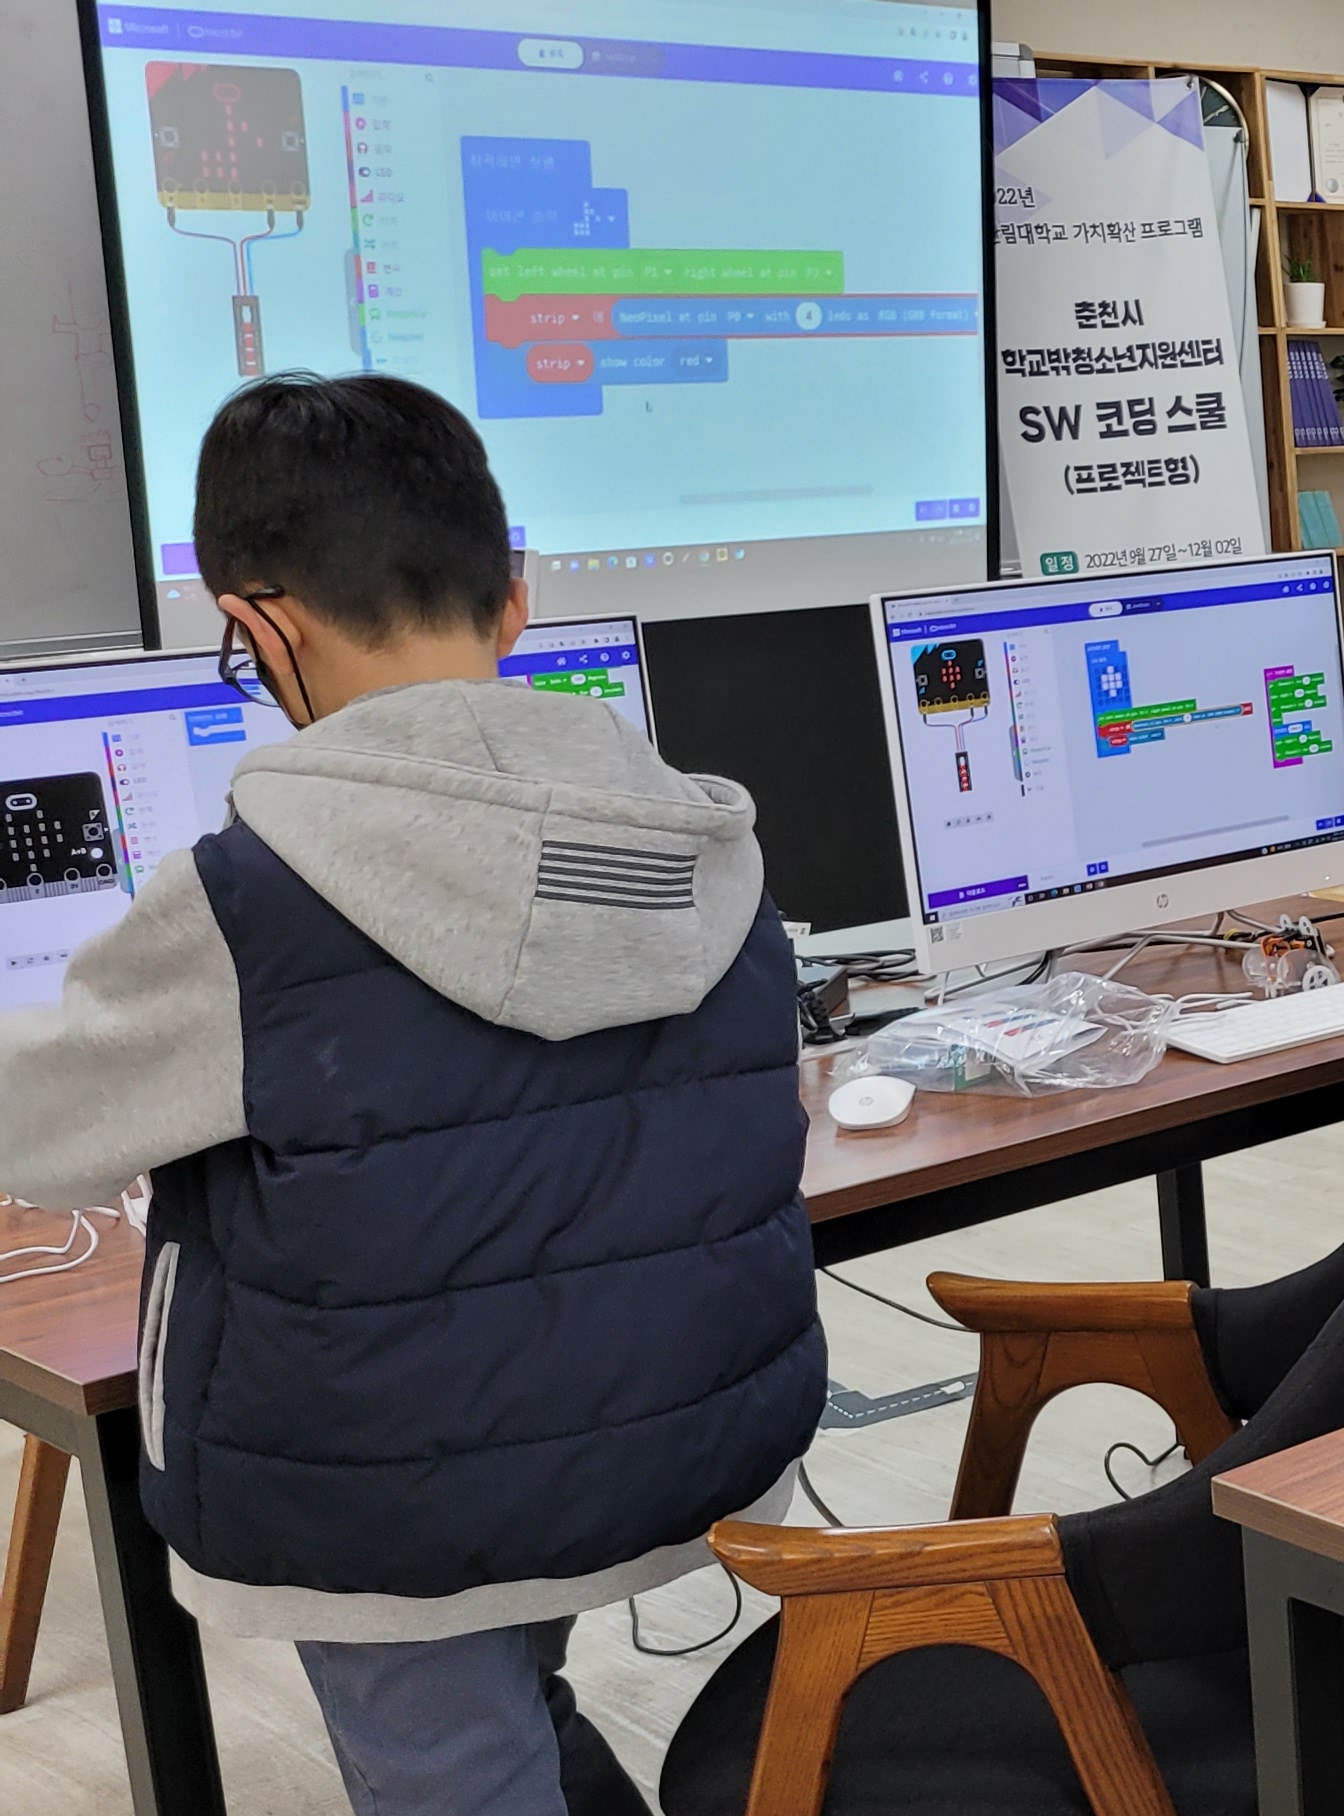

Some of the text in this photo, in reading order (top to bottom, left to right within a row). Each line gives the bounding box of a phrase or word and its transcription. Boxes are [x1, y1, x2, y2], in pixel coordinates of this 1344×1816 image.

[994, 186, 1036, 209] 22년
[1072, 221, 1136, 244] 가치확산
[1140, 217, 1203, 240] 프로그램
[518, 265, 545, 278] left
[551, 265, 586, 278] wheel
[685, 266, 716, 281] right
[530, 312, 566, 326] strip
[619, 310, 673, 324] NeoPixel
[765, 310, 790, 322] with
[828, 309, 851, 322] leds
[930, 308, 969, 323] format)
[1074, 299, 1145, 330] 춘천시
[536, 353, 700, 371] strip show color red
[1001, 337, 1225, 378] 학교밖청소년지원센터
[1019, 391, 1228, 443] SW 코딩 스쿨
[1064, 453, 1200, 496] (프로젝트형)
[1044, 554, 1075, 573] 일정
[1084, 550, 1129, 570] 2022년
[1129, 546, 1146, 566] 9월
[1215, 536, 1243, 556] 02일
